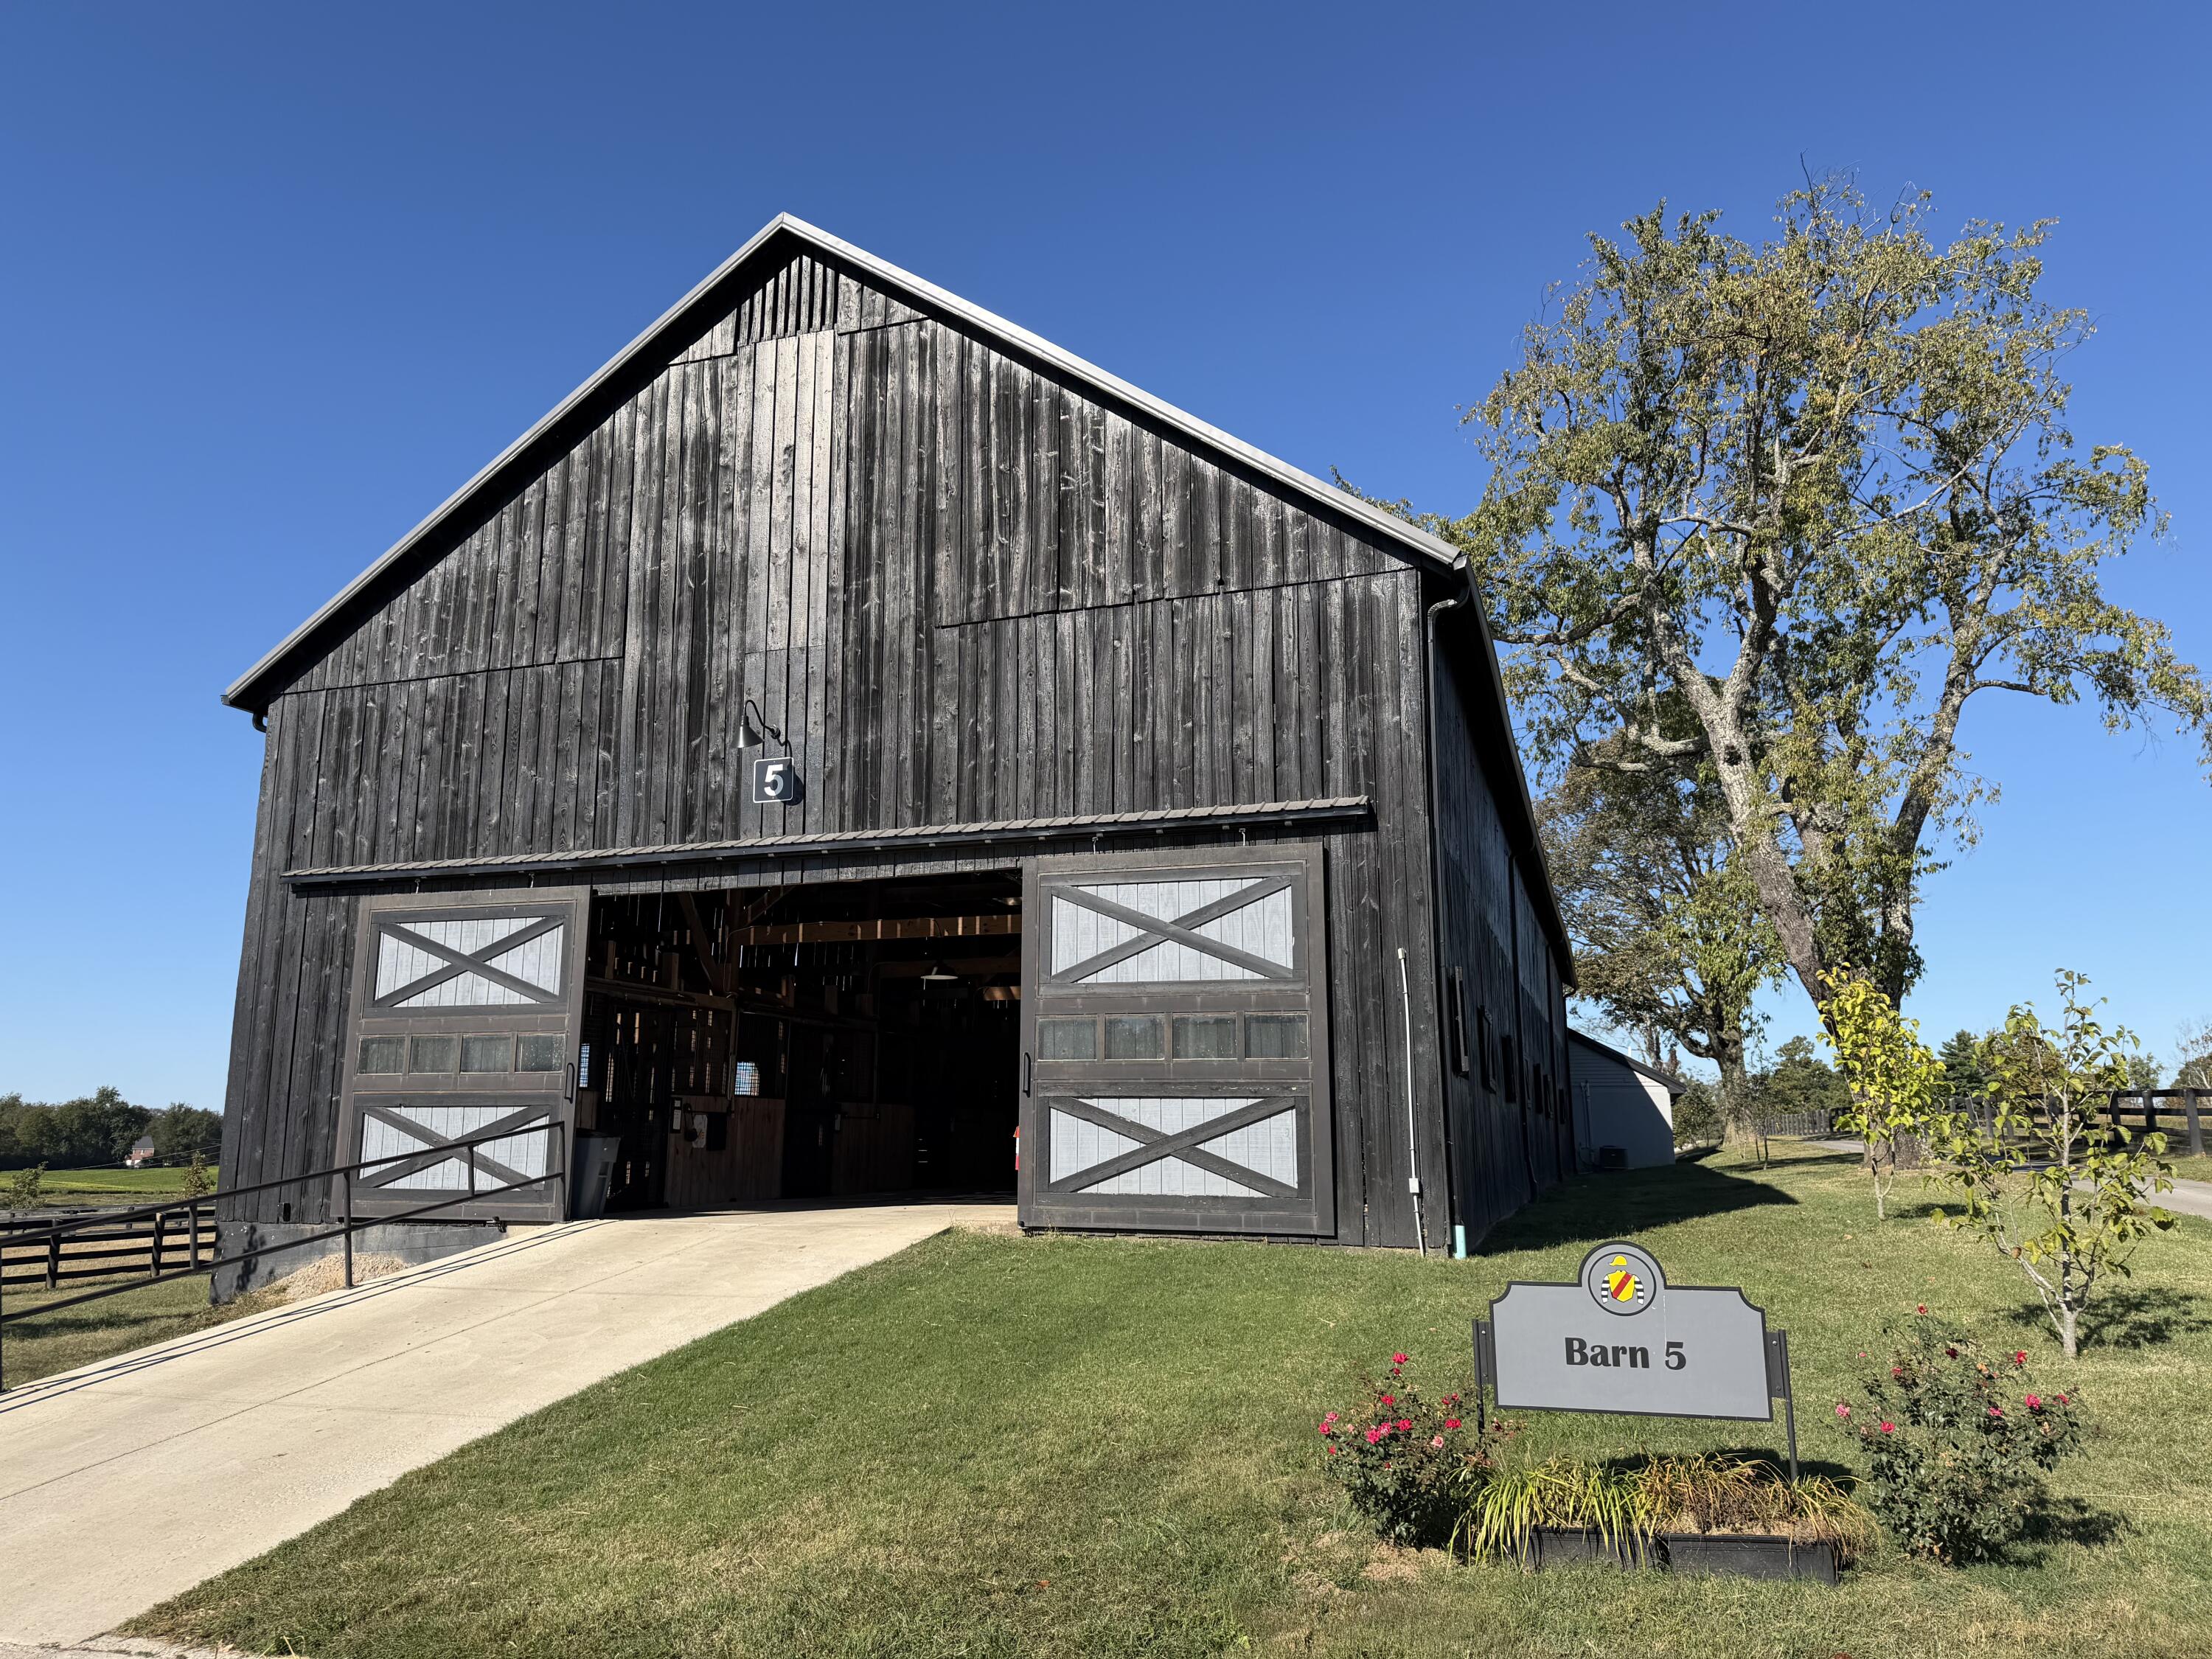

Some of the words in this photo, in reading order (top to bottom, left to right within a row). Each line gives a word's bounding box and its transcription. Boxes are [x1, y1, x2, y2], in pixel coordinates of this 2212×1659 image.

[764, 764, 784, 796] 5
[1565, 1337, 1650, 1368] Barn
[1665, 1341, 1687, 1370] 5
